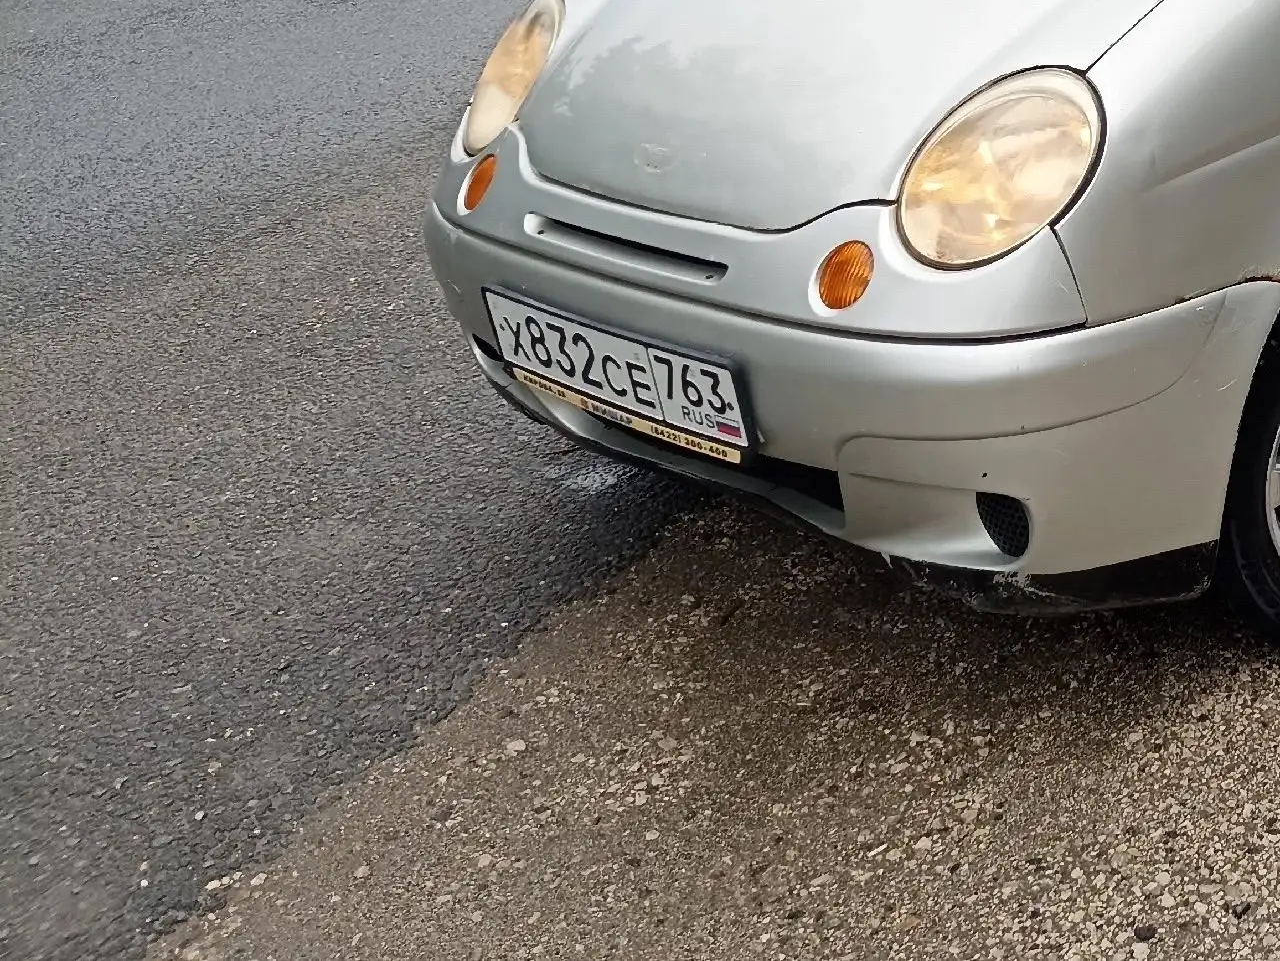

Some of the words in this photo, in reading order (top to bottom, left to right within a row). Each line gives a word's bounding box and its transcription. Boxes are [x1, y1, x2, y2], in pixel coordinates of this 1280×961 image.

[502, 315, 657, 410] Х832СЕ
[653, 354, 727, 415] 763
[681, 404, 715, 429] RUS
